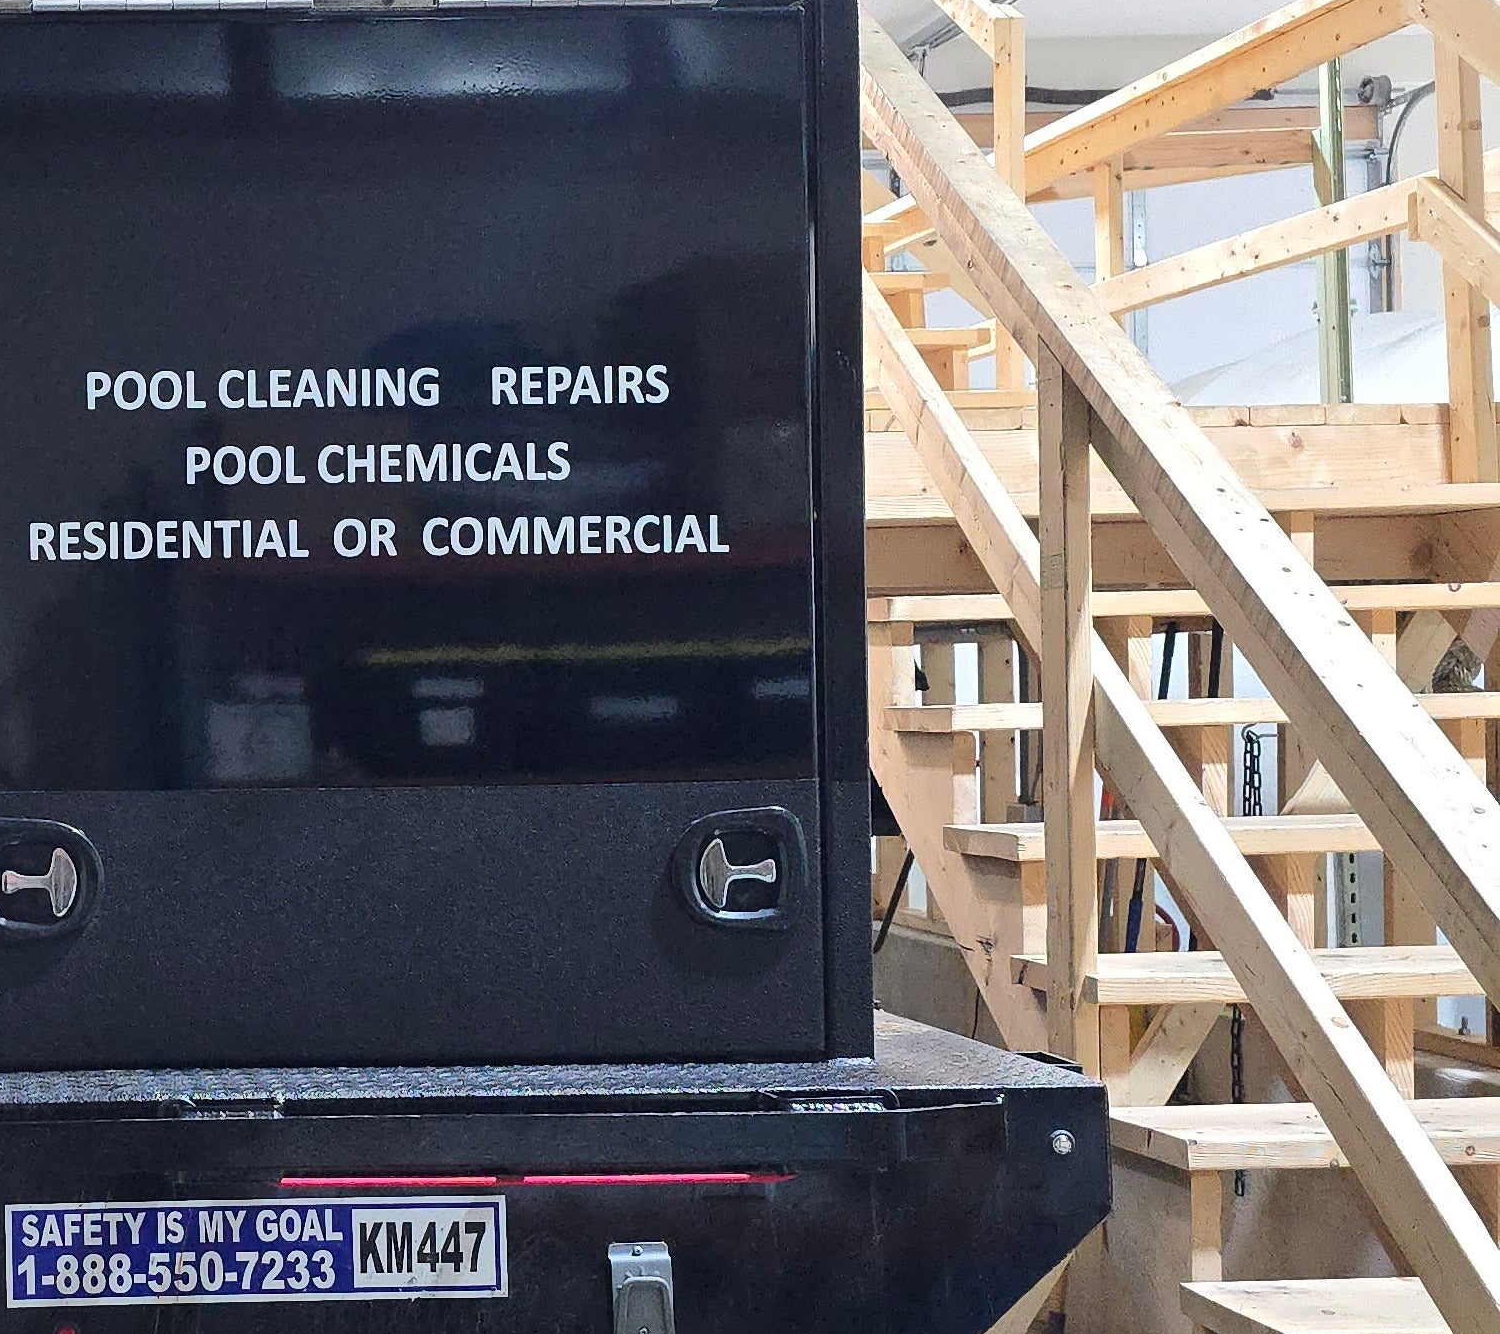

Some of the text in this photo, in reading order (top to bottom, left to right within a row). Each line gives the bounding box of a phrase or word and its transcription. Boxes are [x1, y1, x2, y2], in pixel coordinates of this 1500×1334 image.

[86, 364, 670, 411] POOL CLEANING REPAIRS
[186, 441, 571, 485] POOL CHEMICALS
[29, 514, 730, 561] RESIDENTIAL OR COMMERCIAL
[21, 1208, 344, 1248] SAFETY IS MY GOAL
[358, 1221, 488, 1274] KM447
[17, 1249, 336, 1296] 1-888-550-7233
